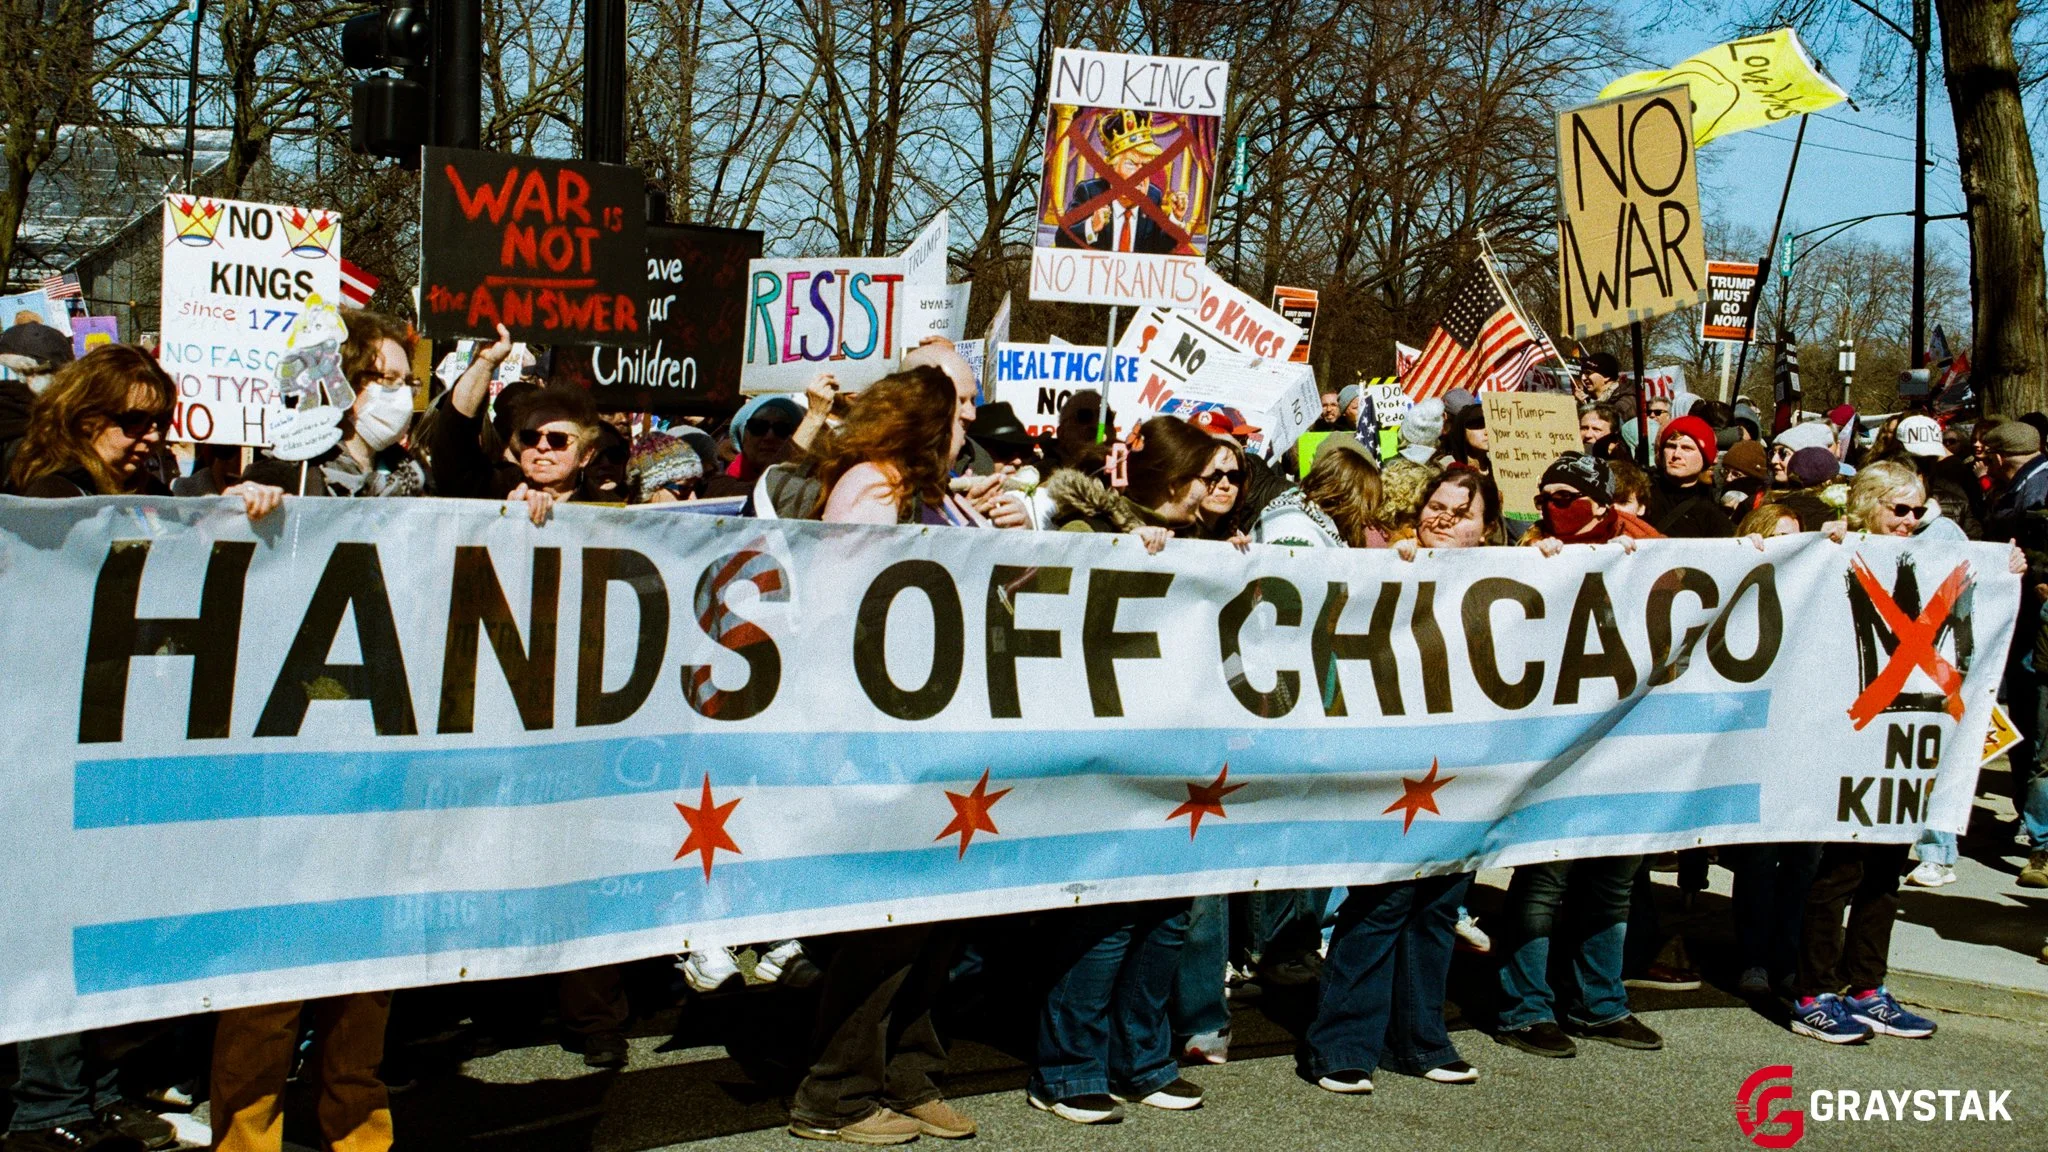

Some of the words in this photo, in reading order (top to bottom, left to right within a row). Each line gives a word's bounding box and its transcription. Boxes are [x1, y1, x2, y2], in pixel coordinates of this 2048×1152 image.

[1056, 55, 1105, 103] NO
[1121, 59, 1220, 110] KINGS
[1572, 97, 1688, 211] NO
[444, 164, 591, 224] WAR
[229, 205, 273, 240] NO
[501, 221, 599, 273] NOT
[908, 227, 941, 276] TRUMP
[1566, 199, 1698, 318] WAR
[210, 261, 314, 302] KINGS
[1034, 255, 1076, 292] NO
[1082, 255, 1198, 302] TYRANTS
[1710, 275, 1756, 290] TRUMP
[1712, 289, 1750, 302] MUST
[179, 301, 236, 321] since
[467, 284, 638, 333] ANSWER
[747, 269, 904, 365] RESIST
[920, 299, 943, 310] WAR
[1712, 314, 1747, 327] NOW!
[1720, 302, 1740, 314] GO
[1216, 300, 1285, 358] KINGS
[165, 342, 203, 364] NO
[591, 339, 697, 389] Children
[998, 350, 1140, 382] HEALTHCARE
[1170, 332, 1206, 375] NO
[1489, 399, 1512, 425] Hey
[1495, 448, 1509, 461] and
[1532, 449, 1547, 460] the
[1515, 430, 1529, 439] ass
[1534, 430, 1542, 439] is
[1549, 432, 1574, 444] grass
[78, 540, 792, 745] HANDS
[853, 558, 1175, 720] OFF
[1218, 562, 1784, 718] CHICAGO
[1885, 723, 1941, 769] NO
